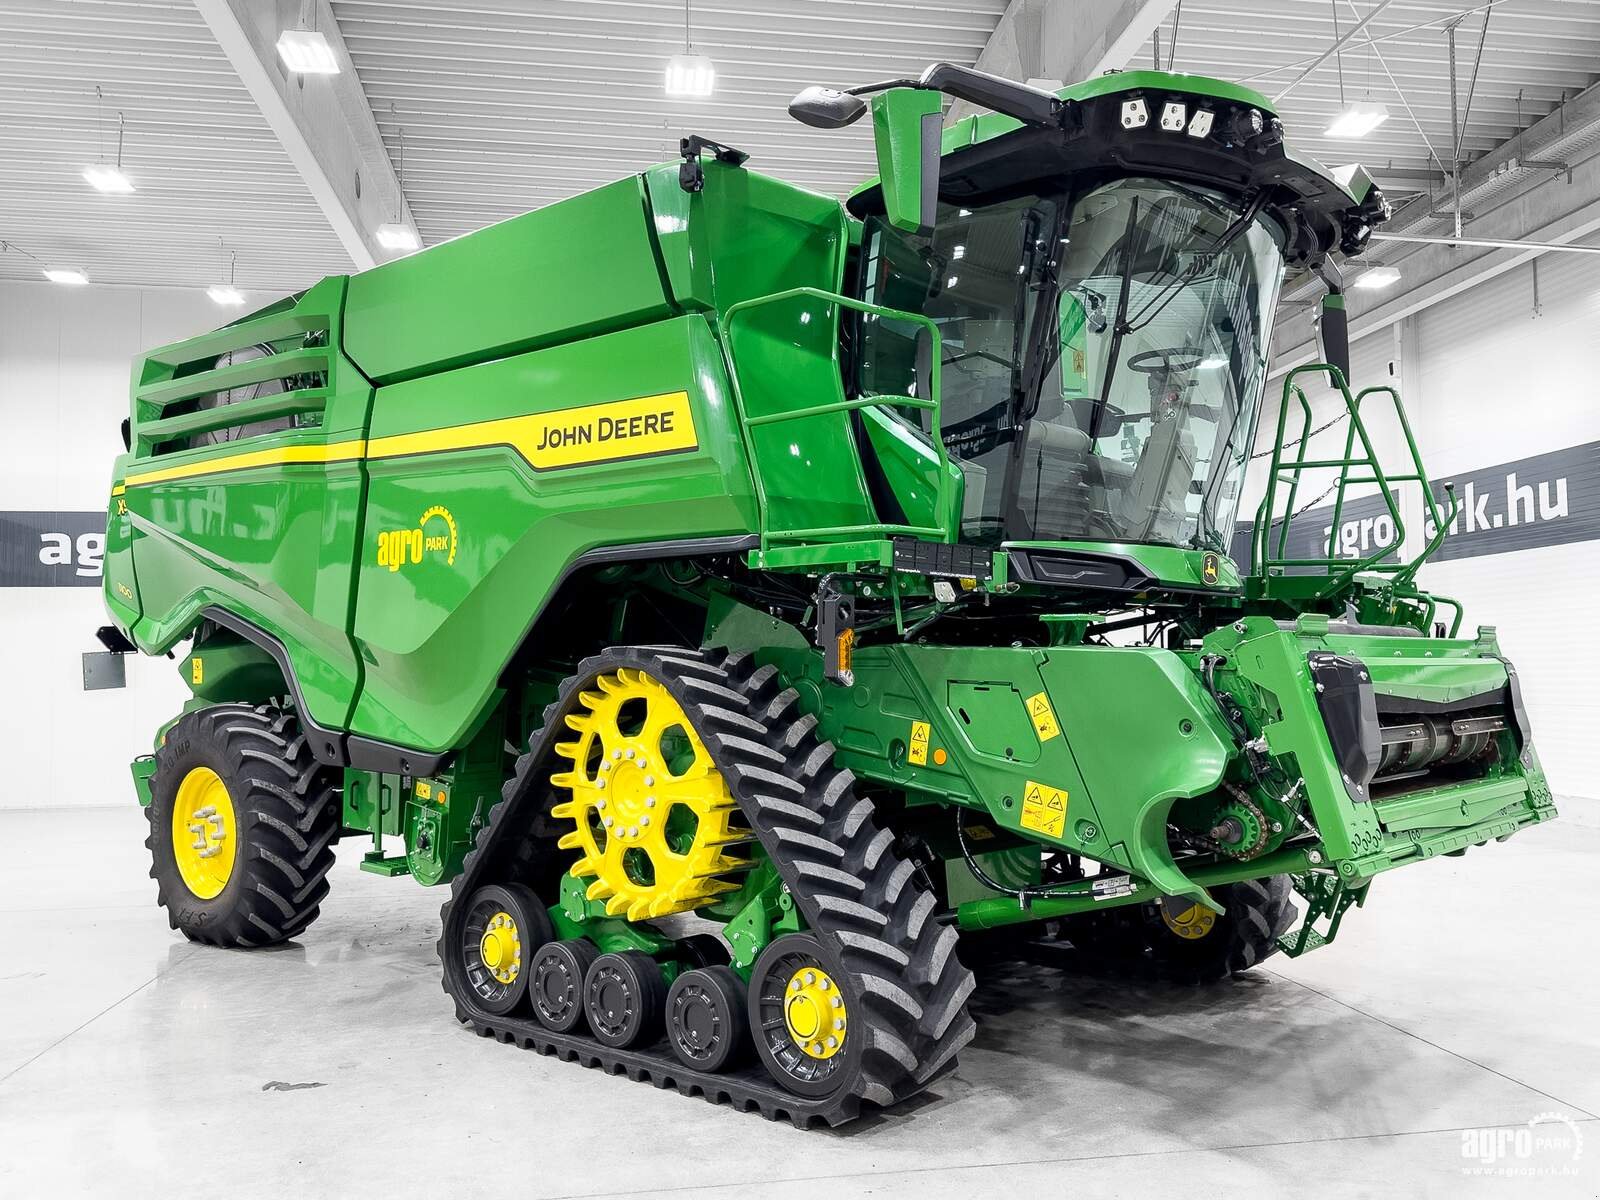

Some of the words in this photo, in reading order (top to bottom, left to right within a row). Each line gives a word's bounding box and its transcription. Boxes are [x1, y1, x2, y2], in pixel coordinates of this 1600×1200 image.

[537, 424, 592, 450] JOHN
[598, 411, 674, 442] DEERE
[377, 528, 423, 572] agro
[425, 536, 449, 552] PARK
